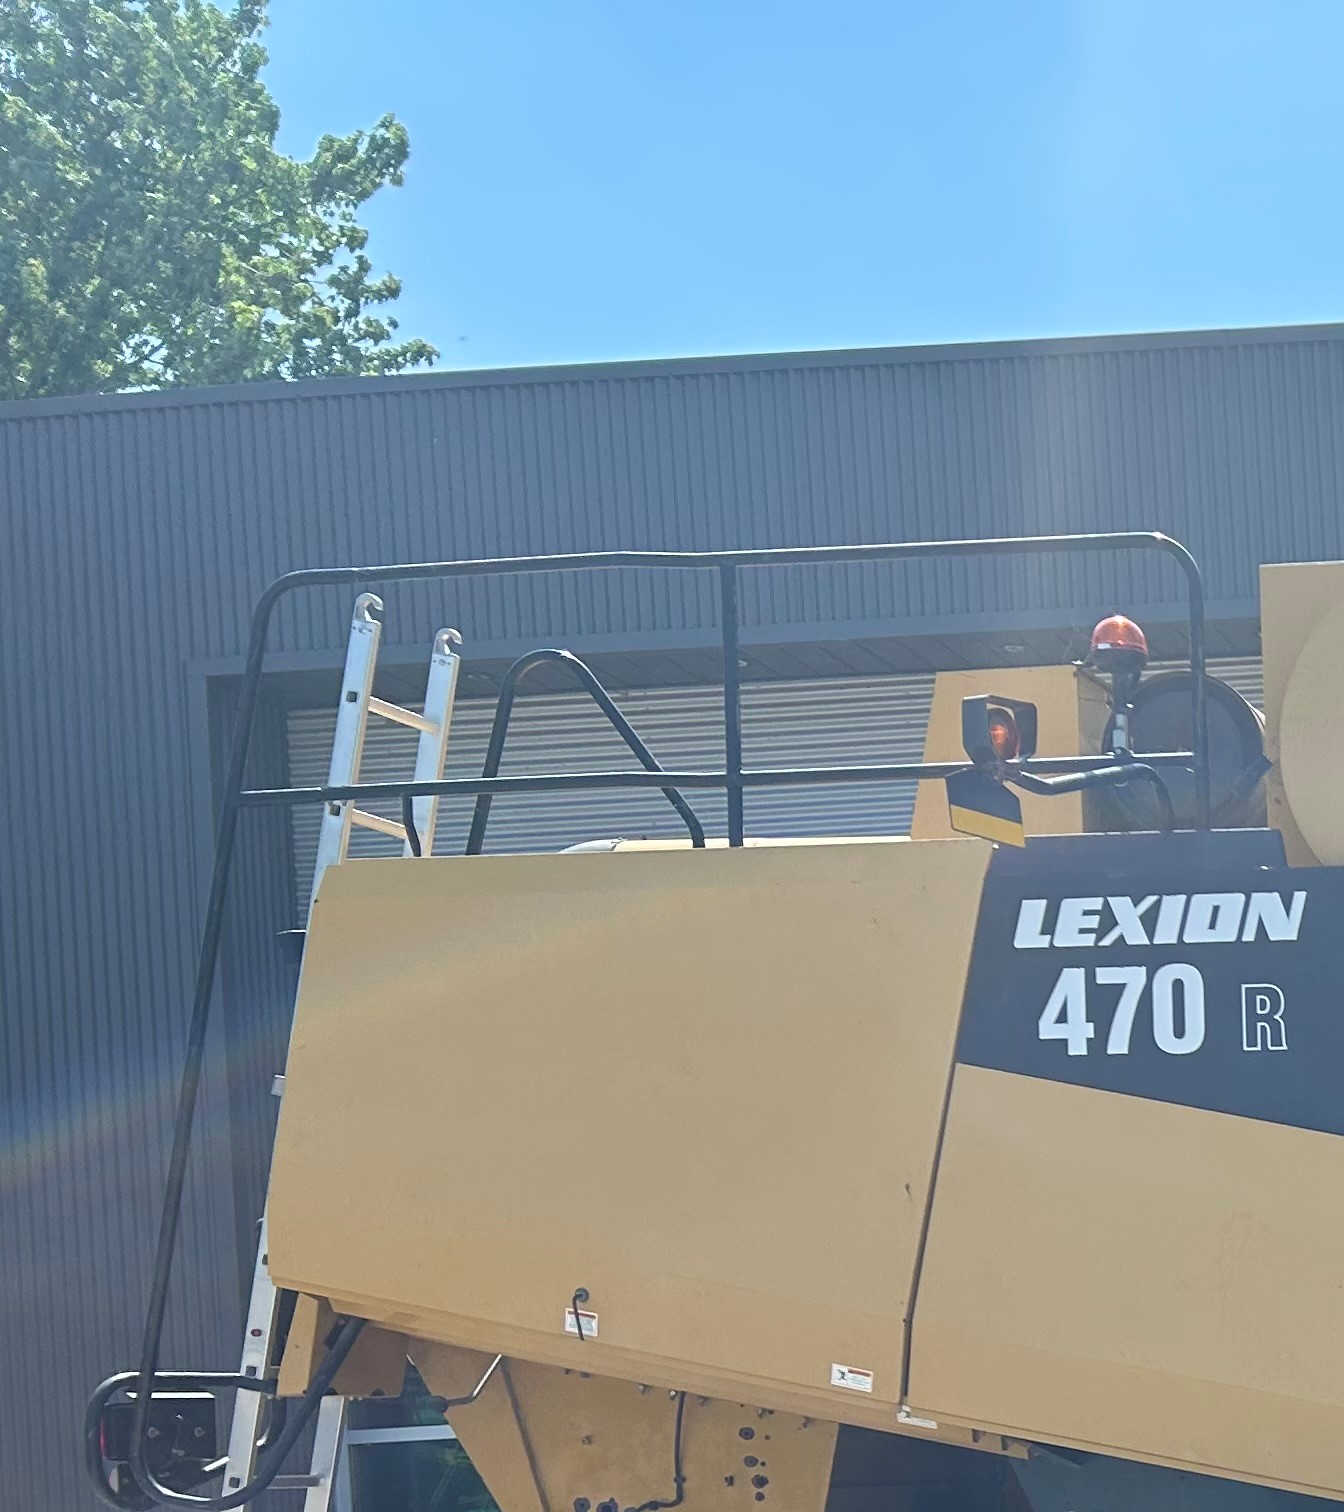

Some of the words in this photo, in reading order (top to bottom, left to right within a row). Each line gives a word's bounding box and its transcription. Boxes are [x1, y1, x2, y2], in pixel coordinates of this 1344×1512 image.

[1013, 890, 1307, 948] LEXION
[1038, 962, 1205, 1056] 470
[1241, 983, 1288, 1051] R
